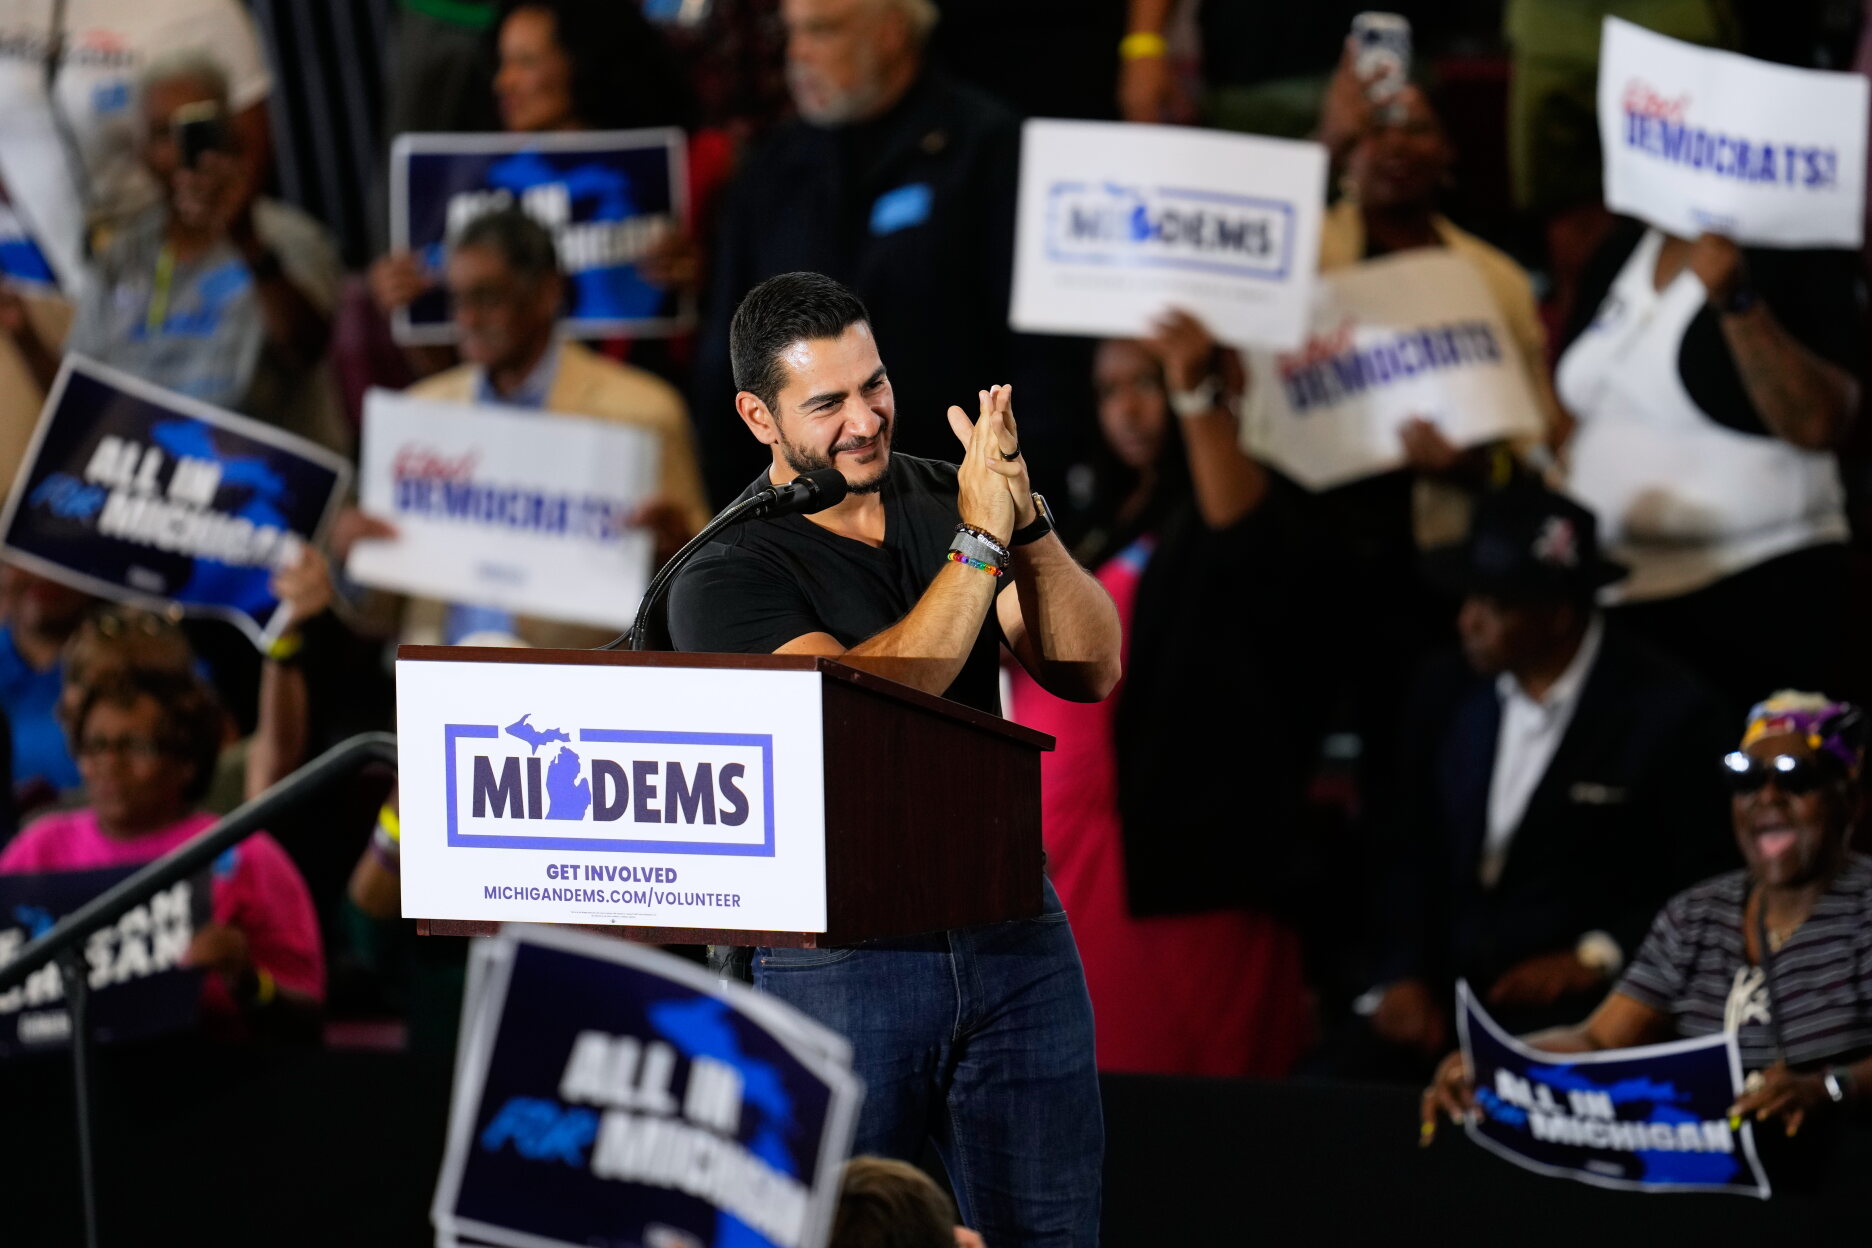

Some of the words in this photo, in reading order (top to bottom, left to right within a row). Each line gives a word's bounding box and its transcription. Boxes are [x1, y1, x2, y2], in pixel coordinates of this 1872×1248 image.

[547, 864, 580, 880] GET
[585, 865, 677, 884] INVOLVED
[484, 886, 741, 908] MICHIGANDEMS.COM/VOLUNTEER
[1529, 1109, 1735, 1154] MICHIGAN
